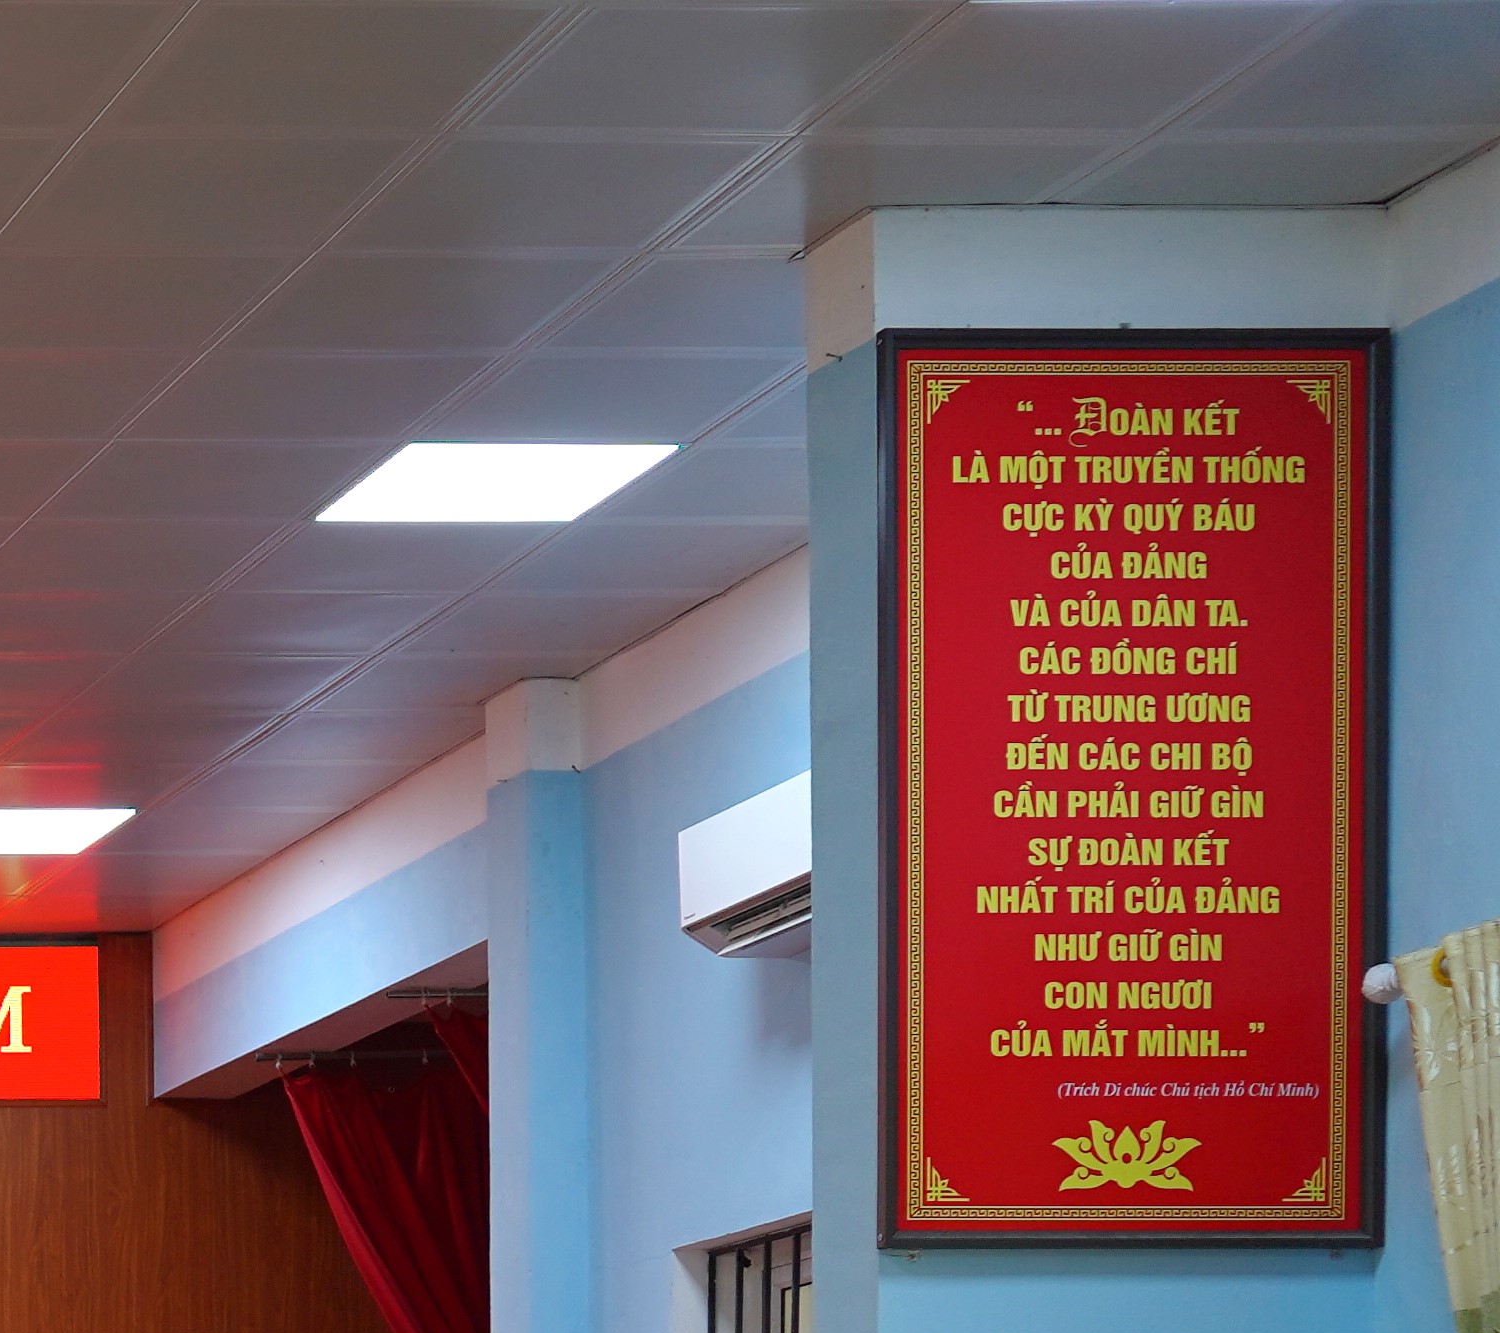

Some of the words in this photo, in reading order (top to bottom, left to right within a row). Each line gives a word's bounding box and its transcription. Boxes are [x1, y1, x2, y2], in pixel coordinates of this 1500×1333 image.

[1070, 397, 1172, 450] ĐOÀN
[1184, 400, 1239, 435] KẾT
[953, 450, 989, 483] LÀ
[1000, 450, 1067, 489] MỘT
[1074, 447, 1194, 484] TRUYỀN
[1203, 447, 1304, 483] THỐNG
[1003, 501, 1064, 537] CỰC
[1075, 498, 1113, 531] KỲ
[1124, 498, 1183, 534] QUÝ
[1194, 498, 1254, 531] BÁU
[1051, 542, 1113, 579] CỦA
[1122, 543, 1206, 579] ĐẢNG
[977, 876, 1058, 913] NHẤT
[1067, 880, 1114, 913] TRÍ
[1125, 877, 1186, 913] CỦA
[1195, 877, 1279, 913] ĐẢNG
[1045, 982, 1107, 1009] CON
[1118, 980, 1211, 1009] NGƯƠI
[991, 1020, 1052, 1056] CỦA
[1063, 1019, 1128, 1056] MẮT
[1058, 1082, 1099, 1100] (Trích
[1104, 1083, 1121, 1097] Di
[1125, 1082, 1157, 1097] chúc
[1161, 1082, 1190, 1097] Chủ
[1194, 1083, 1219, 1099] tịch
[1224, 1080, 1245, 1097] Hồ
[1249, 1082, 1273, 1097] Chí
[1278, 1083, 1320, 1099] Minh)
